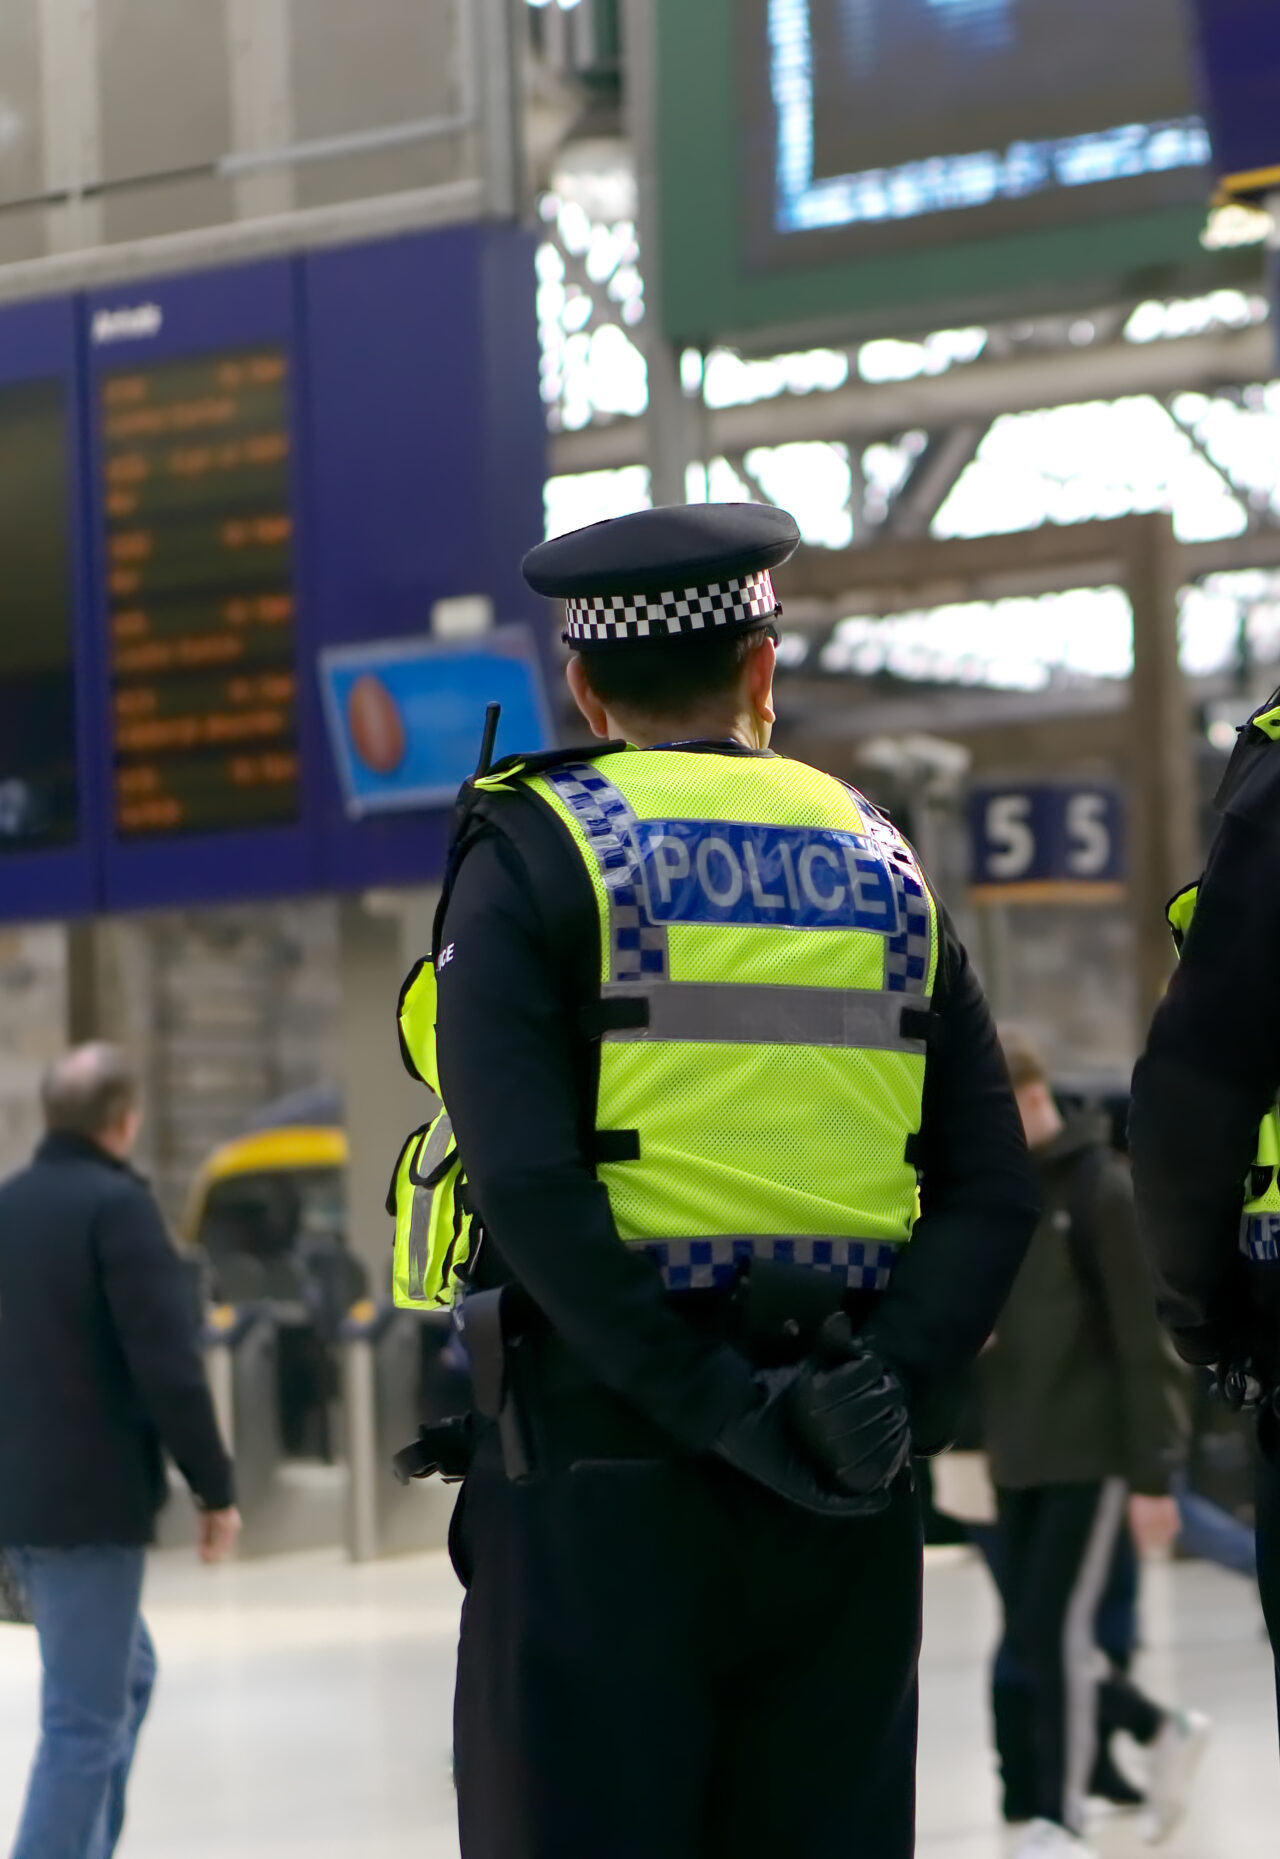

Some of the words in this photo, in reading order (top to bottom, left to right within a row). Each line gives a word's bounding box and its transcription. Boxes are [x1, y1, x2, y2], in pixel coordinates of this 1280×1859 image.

[649, 835, 887, 915] POLICE
[985, 794, 1035, 878] 5
[1066, 794, 1111, 875] 5
